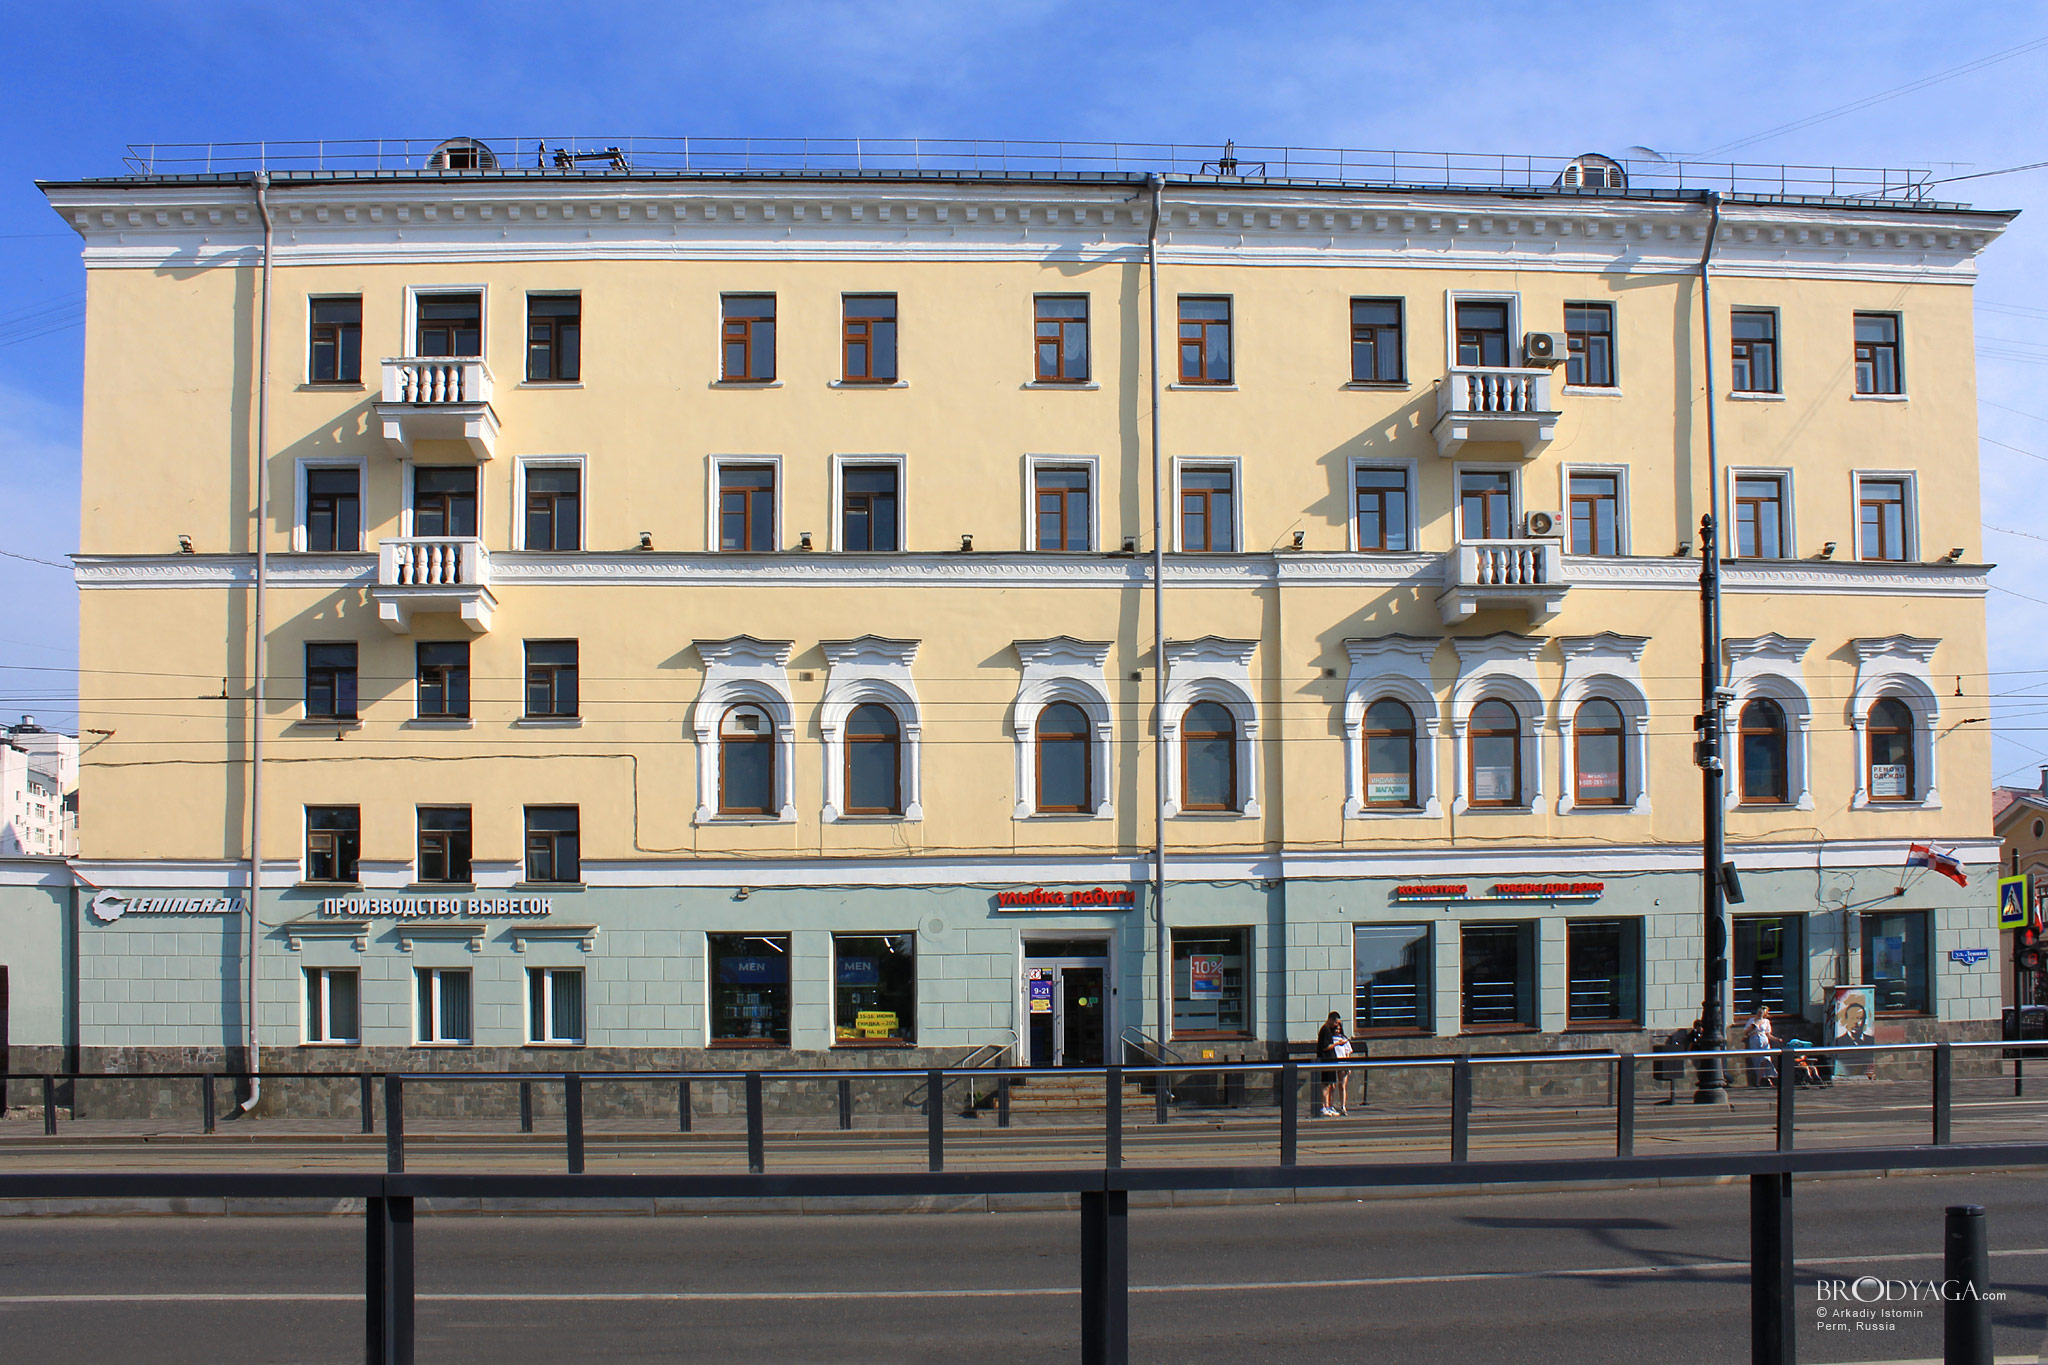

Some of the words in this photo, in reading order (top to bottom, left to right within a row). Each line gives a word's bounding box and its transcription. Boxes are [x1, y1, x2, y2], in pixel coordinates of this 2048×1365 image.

[1398, 883, 1468, 895] косметика
[1494, 883, 1543, 894] товары
[1544, 883, 1570, 893] для
[1572, 882, 1605, 892] дома
[998, 887, 1066, 908] улыбка
[1071, 887, 1136, 907] радуги
[126, 897, 247, 913] LENINGRAD
[324, 897, 462, 917] ПРОИЗВОДСТВО
[467, 897, 553, 915] ВЫВЕСОК
[738, 962, 766, 971] MEN
[844, 961, 872, 971] MEN
[1191, 960, 1223, 974] -10%
